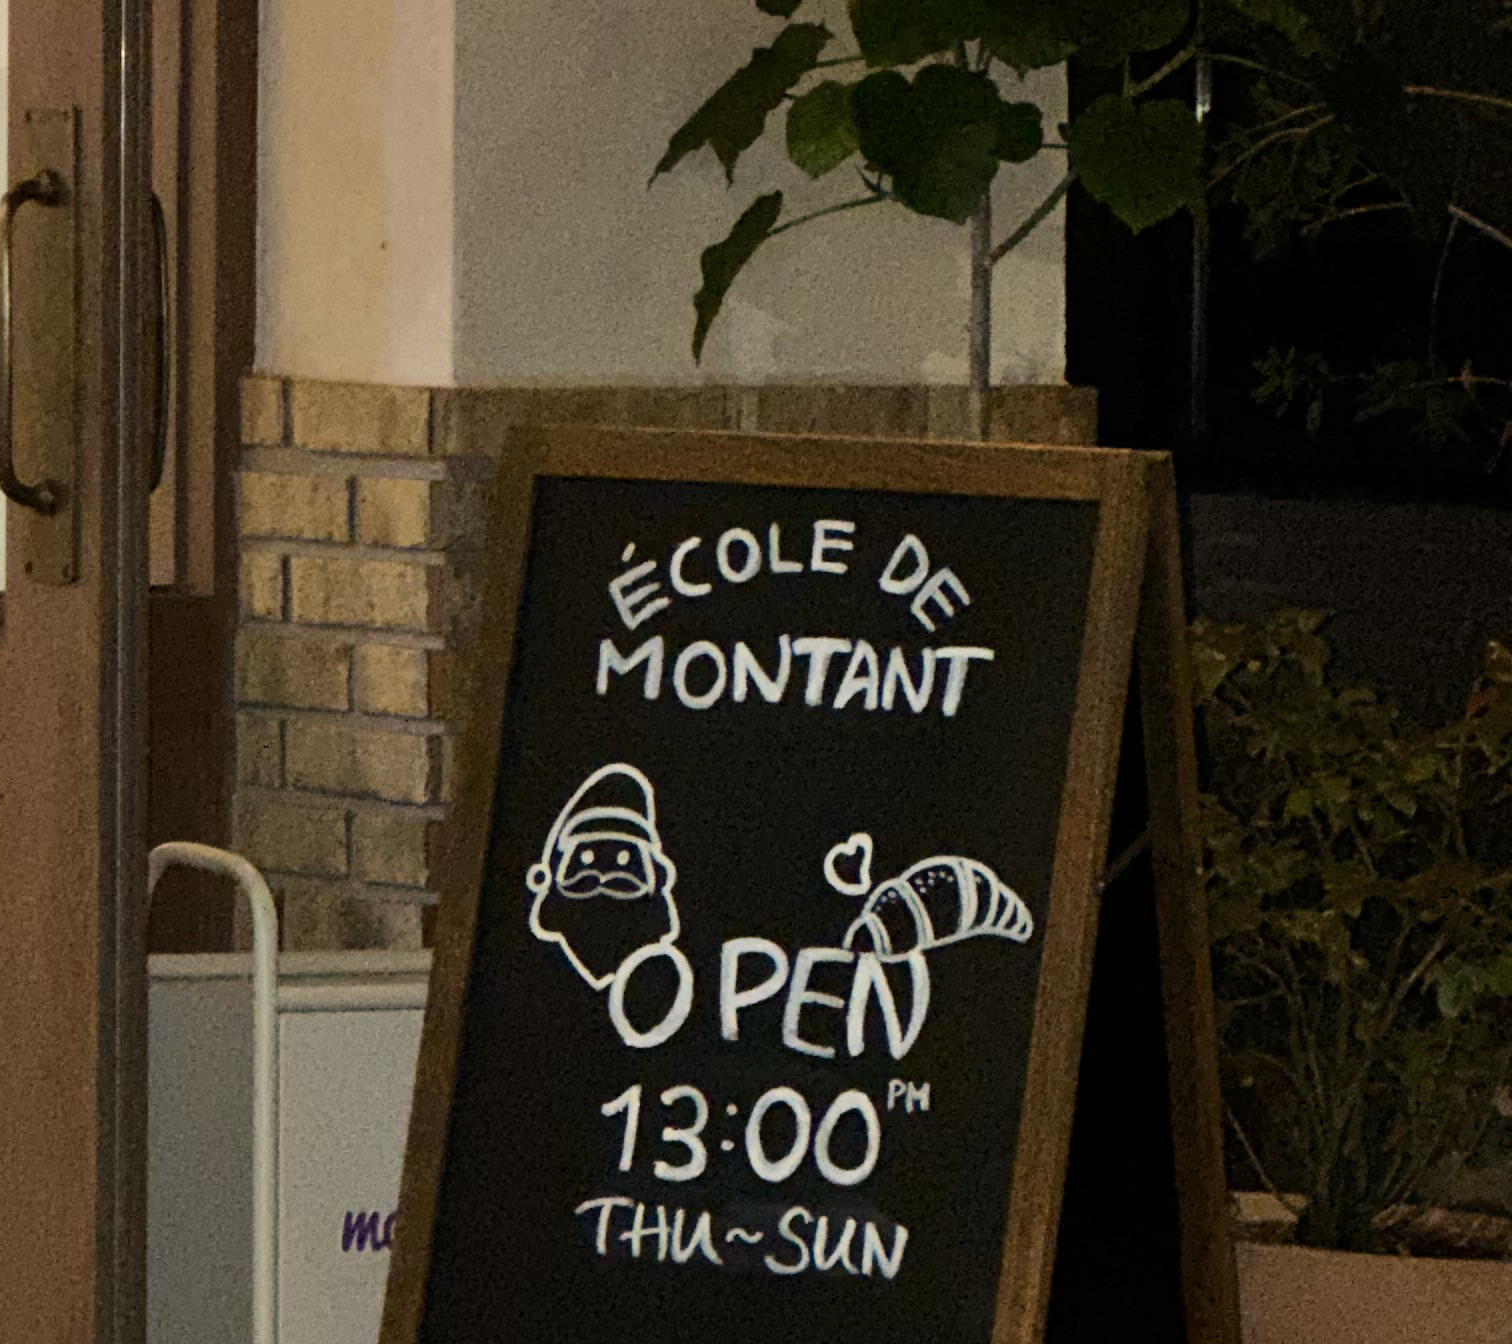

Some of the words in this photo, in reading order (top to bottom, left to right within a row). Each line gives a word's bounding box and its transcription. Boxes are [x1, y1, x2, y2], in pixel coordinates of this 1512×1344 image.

[609, 519, 856, 629] ÉCOLE
[880, 534, 971, 632] DE
[595, 634, 994, 716] MONTANT
[609, 937, 930, 1058] OPEN
[601, 1084, 880, 1186] 13:00
[888, 1079, 930, 1113] PM
